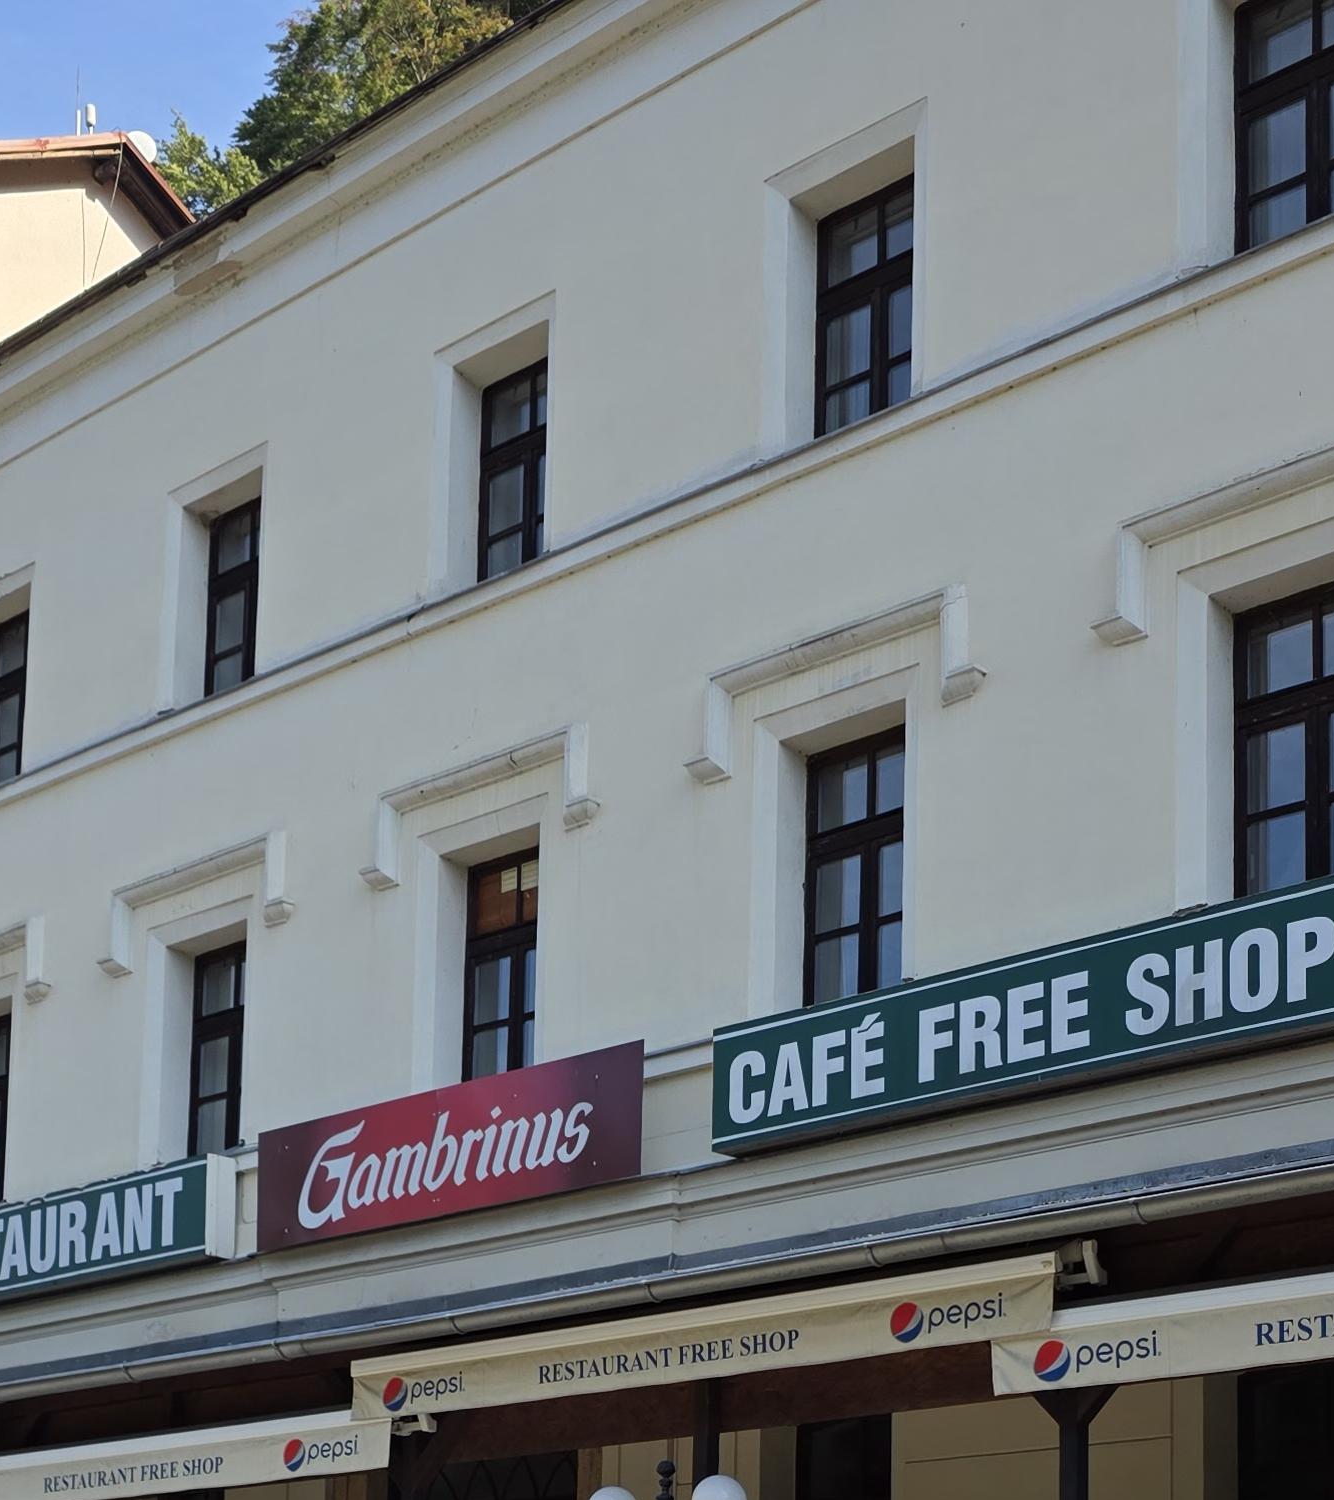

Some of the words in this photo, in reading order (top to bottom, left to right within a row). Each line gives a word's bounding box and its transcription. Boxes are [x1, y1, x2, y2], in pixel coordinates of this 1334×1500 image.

[728, 1012, 885, 1125] CAFÉ
[918, 970, 1090, 1083] FREE
[298, 1101, 593, 1230] Gambrinus
[410, 1370, 465, 1405] pepsi
[539, 1345, 673, 1384] RESTAURANT
[678, 1337, 733, 1366] FREE
[740, 1329, 800, 1358] SHOP
[928, 1292, 1005, 1335] pepsi
[1075, 1330, 1158, 1373] pepsi
[43, 1466, 137, 1493] RESTAURANT
[140, 1461, 178, 1482] FREE
[183, 1456, 224, 1477] SHOP
[306, 1434, 359, 1465] pepsi
